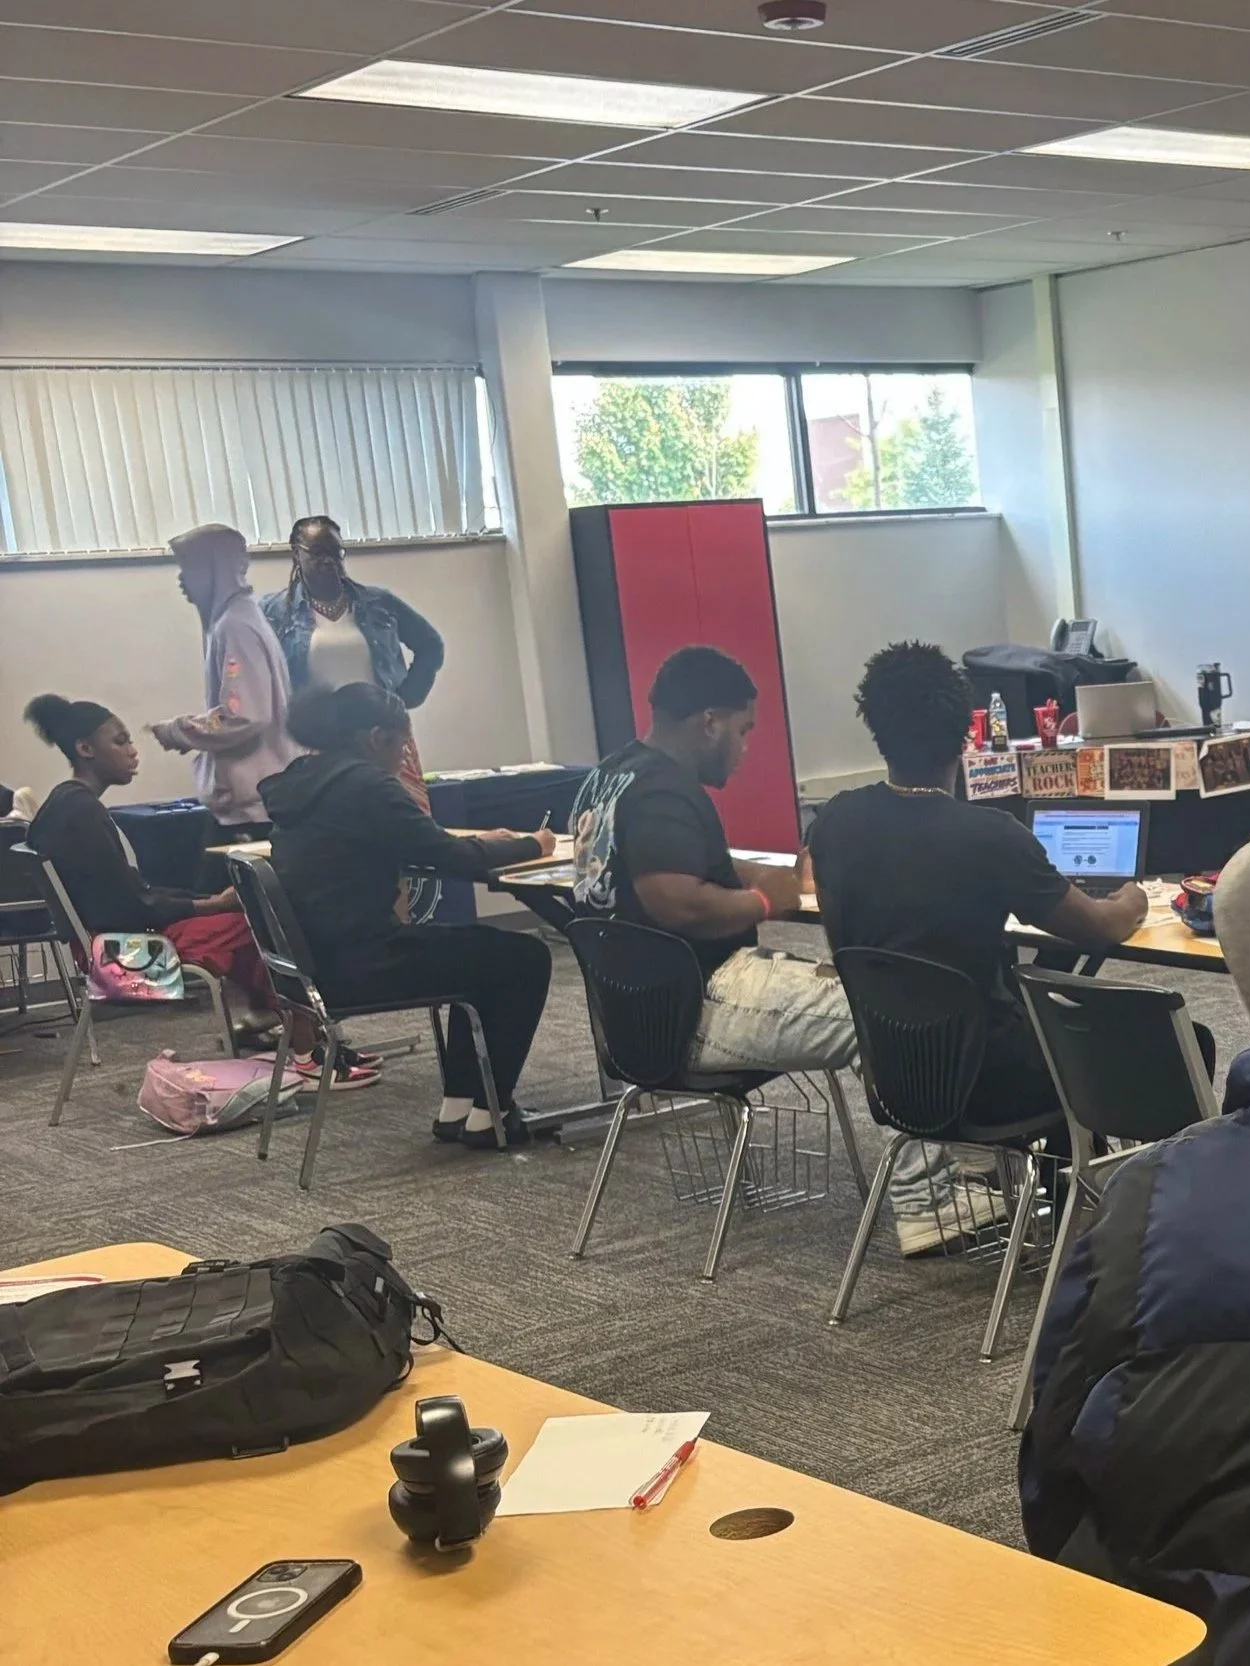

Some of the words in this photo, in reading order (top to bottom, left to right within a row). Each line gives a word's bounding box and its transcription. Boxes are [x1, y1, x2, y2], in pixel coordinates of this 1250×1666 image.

[1026, 762, 1077, 776] TEACHERS
[970, 777, 1018, 793] TEACHERS
[1031, 774, 1075, 791] ROCK
